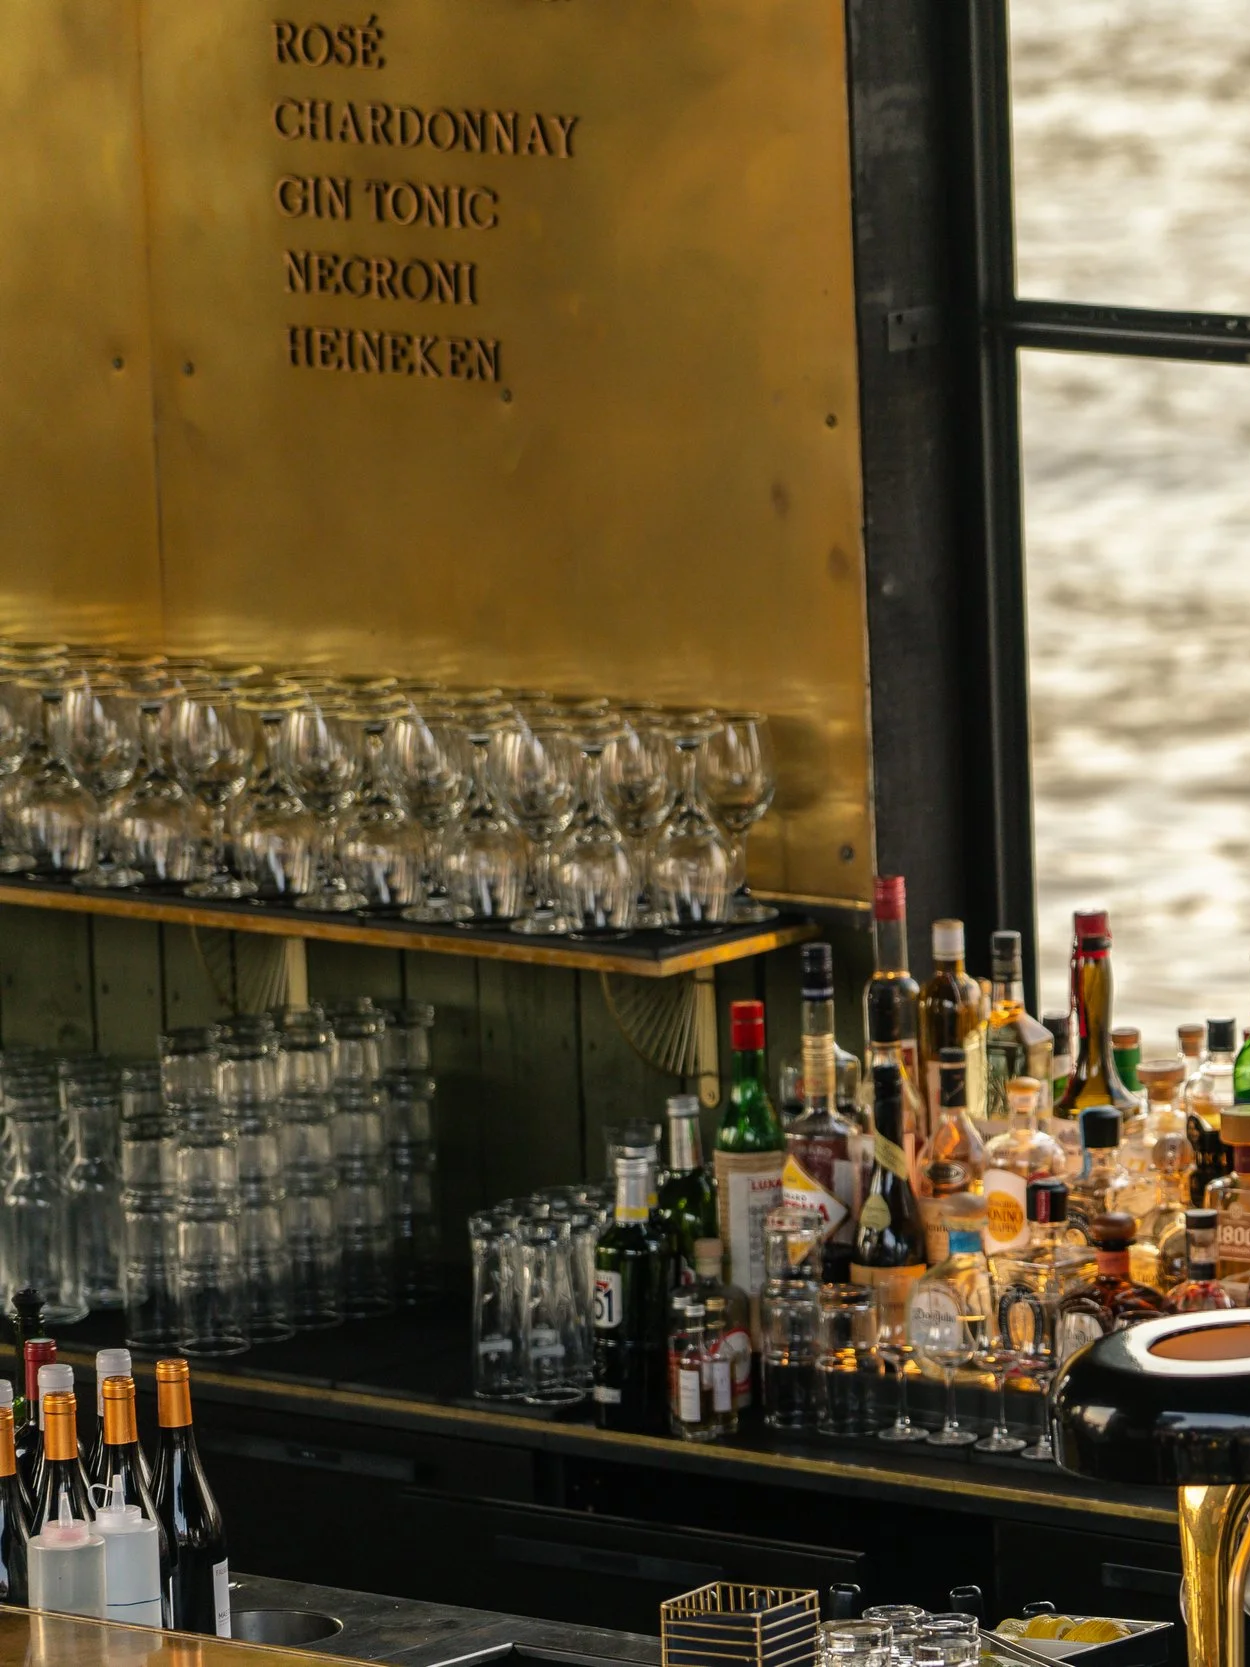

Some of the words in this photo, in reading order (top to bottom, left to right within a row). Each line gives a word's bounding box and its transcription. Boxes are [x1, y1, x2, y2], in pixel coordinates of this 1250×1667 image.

[272, 14, 386, 70] ROSÉ
[273, 98, 579, 158] CHARDONNAY
[275, 175, 351, 221] GIN
[365, 180, 500, 231] TONIC
[284, 250, 478, 305] NEGRONI
[287, 325, 501, 382] HEINEKEN
[751, 1178, 782, 1190] LUXA
